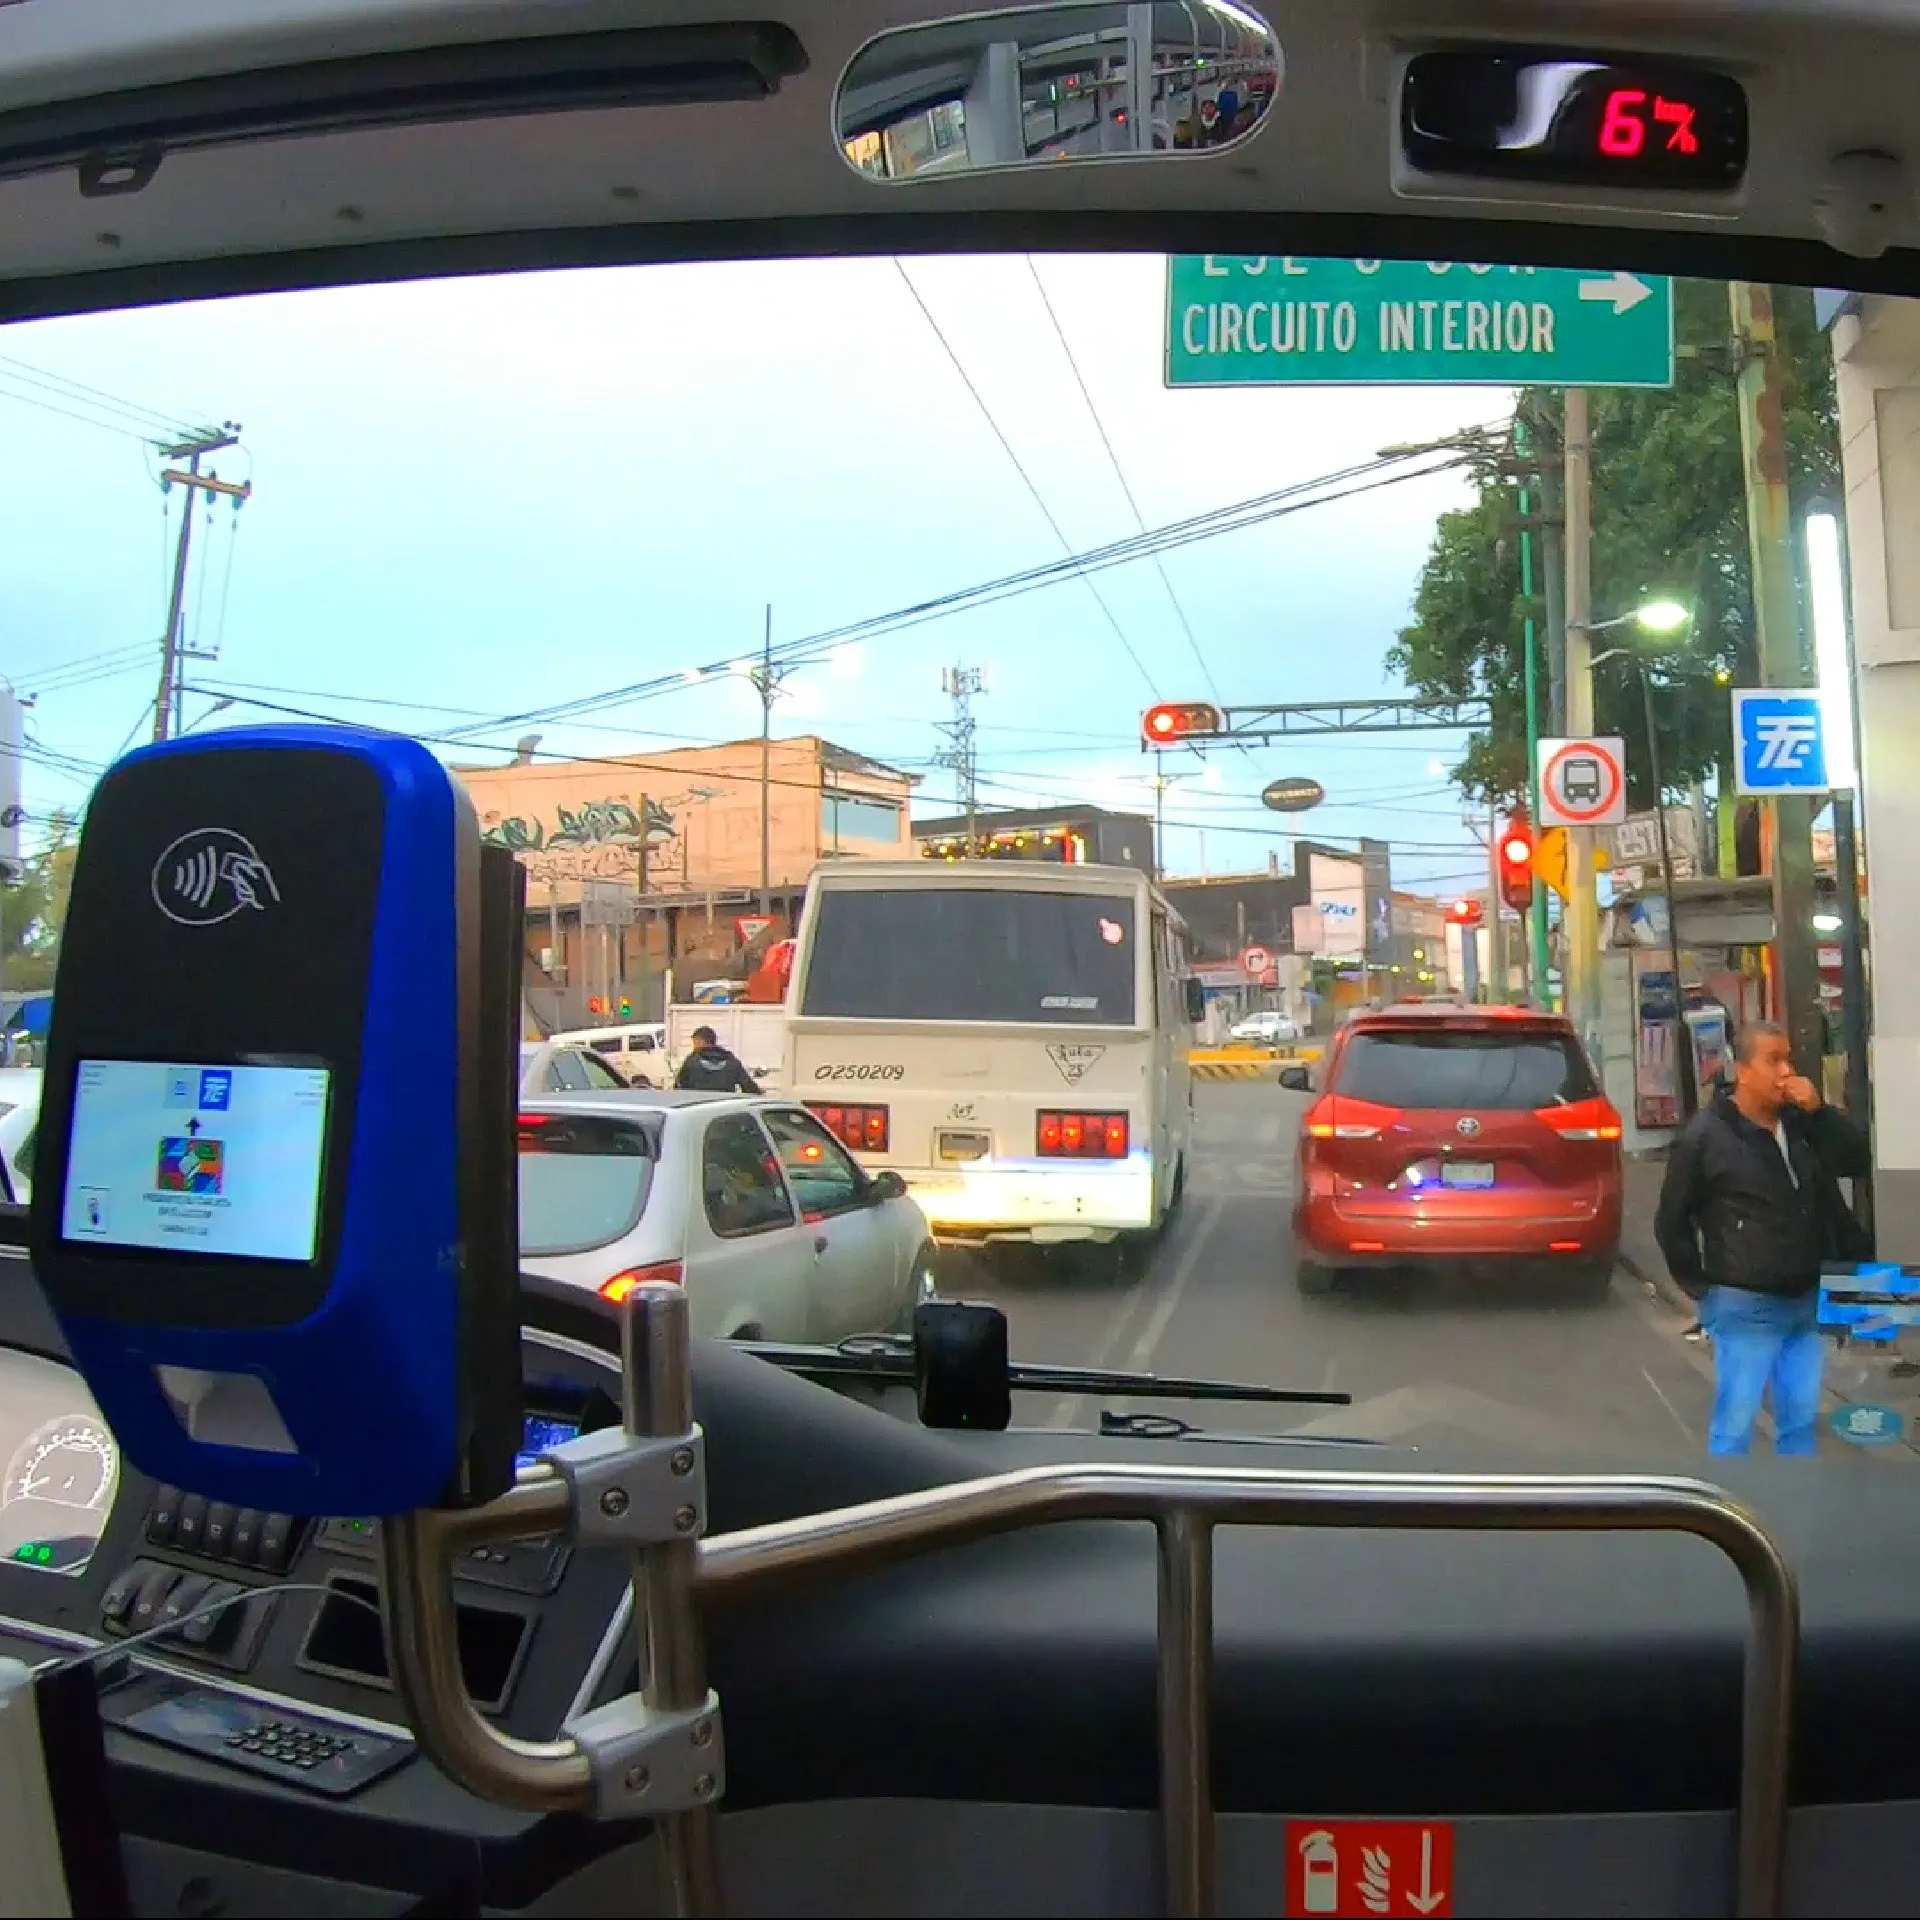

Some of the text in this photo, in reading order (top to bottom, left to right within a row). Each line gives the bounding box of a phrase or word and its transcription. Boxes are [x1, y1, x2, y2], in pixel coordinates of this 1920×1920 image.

[1600, 89, 1647, 157] 6
[1182, 301, 1556, 355] CIRCUITO INTERIOR
[814, 1063, 905, 1081] 0250209
